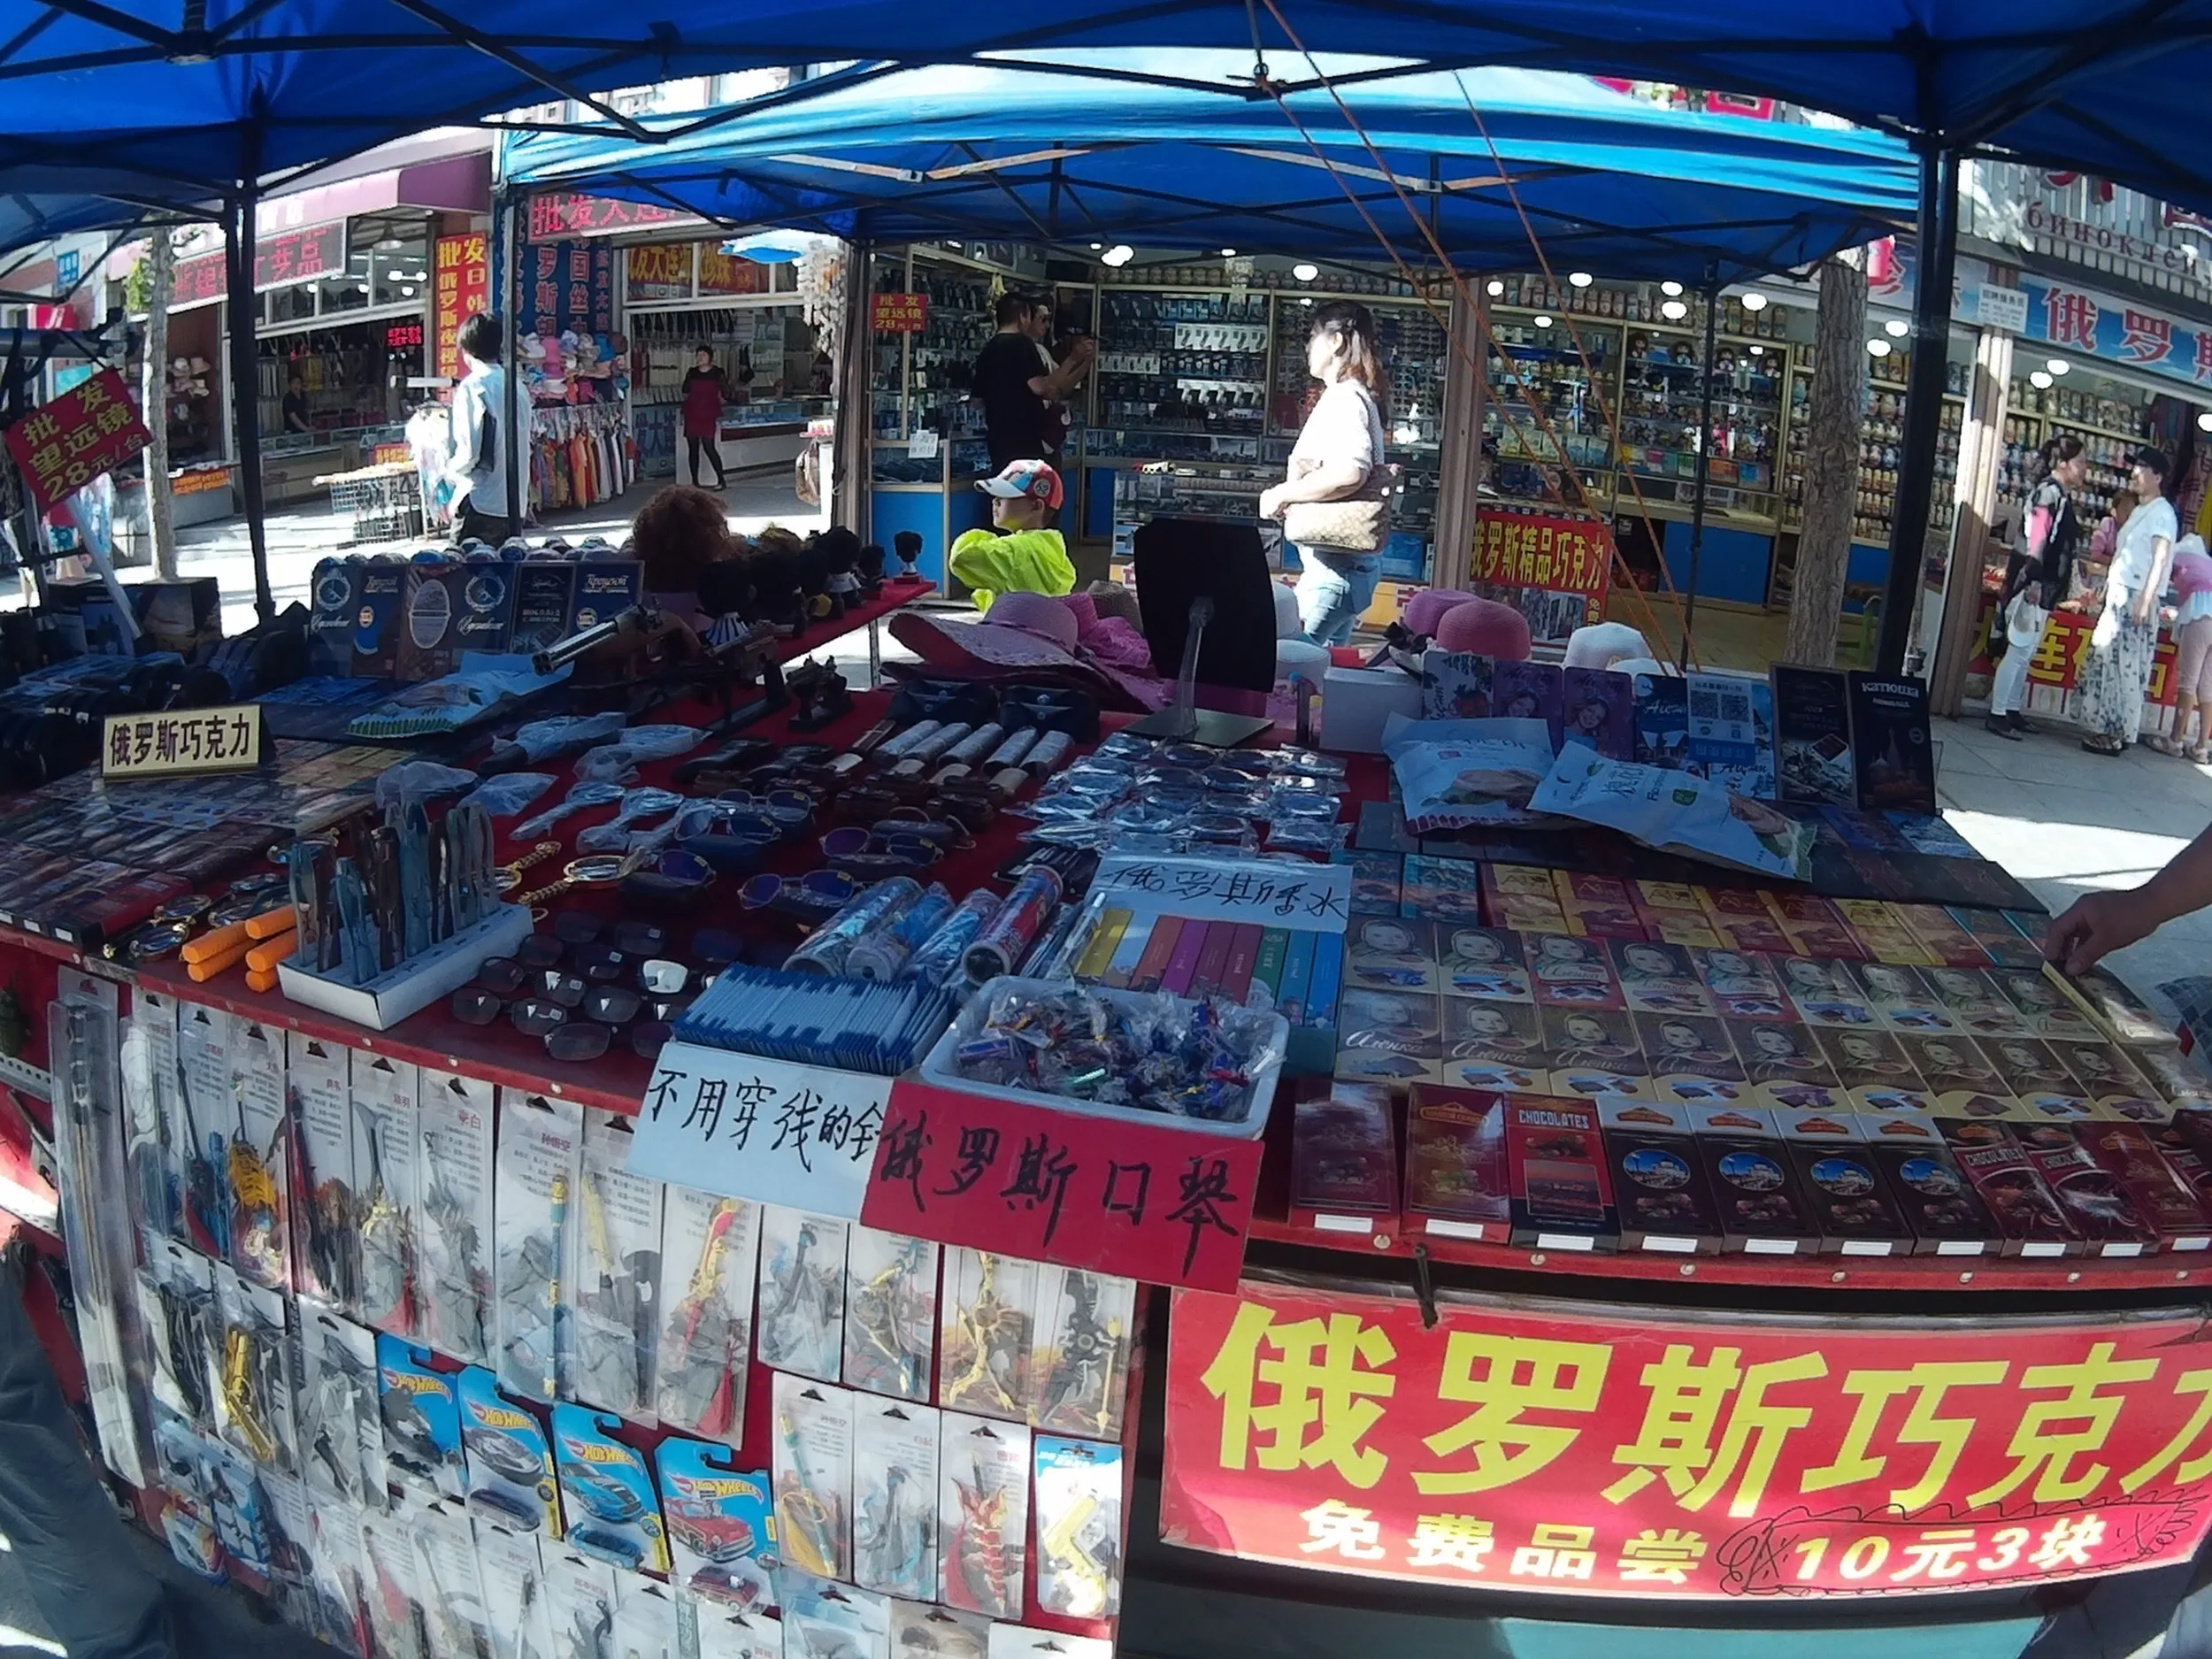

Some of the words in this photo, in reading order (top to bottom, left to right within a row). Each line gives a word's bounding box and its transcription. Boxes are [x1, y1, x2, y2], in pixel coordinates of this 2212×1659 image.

[438, 237, 486, 268] 批发
[28, 401, 134, 480] 望远镜
[43, 433, 143, 503] 28元/台
[109, 712, 250, 768] 俄罗斯巧克力
[1518, 1109, 1590, 1130] CHOCOLATES
[1297, 1497, 1707, 1586] 免费品尝
[1793, 1512, 2108, 1582] 10元3块
